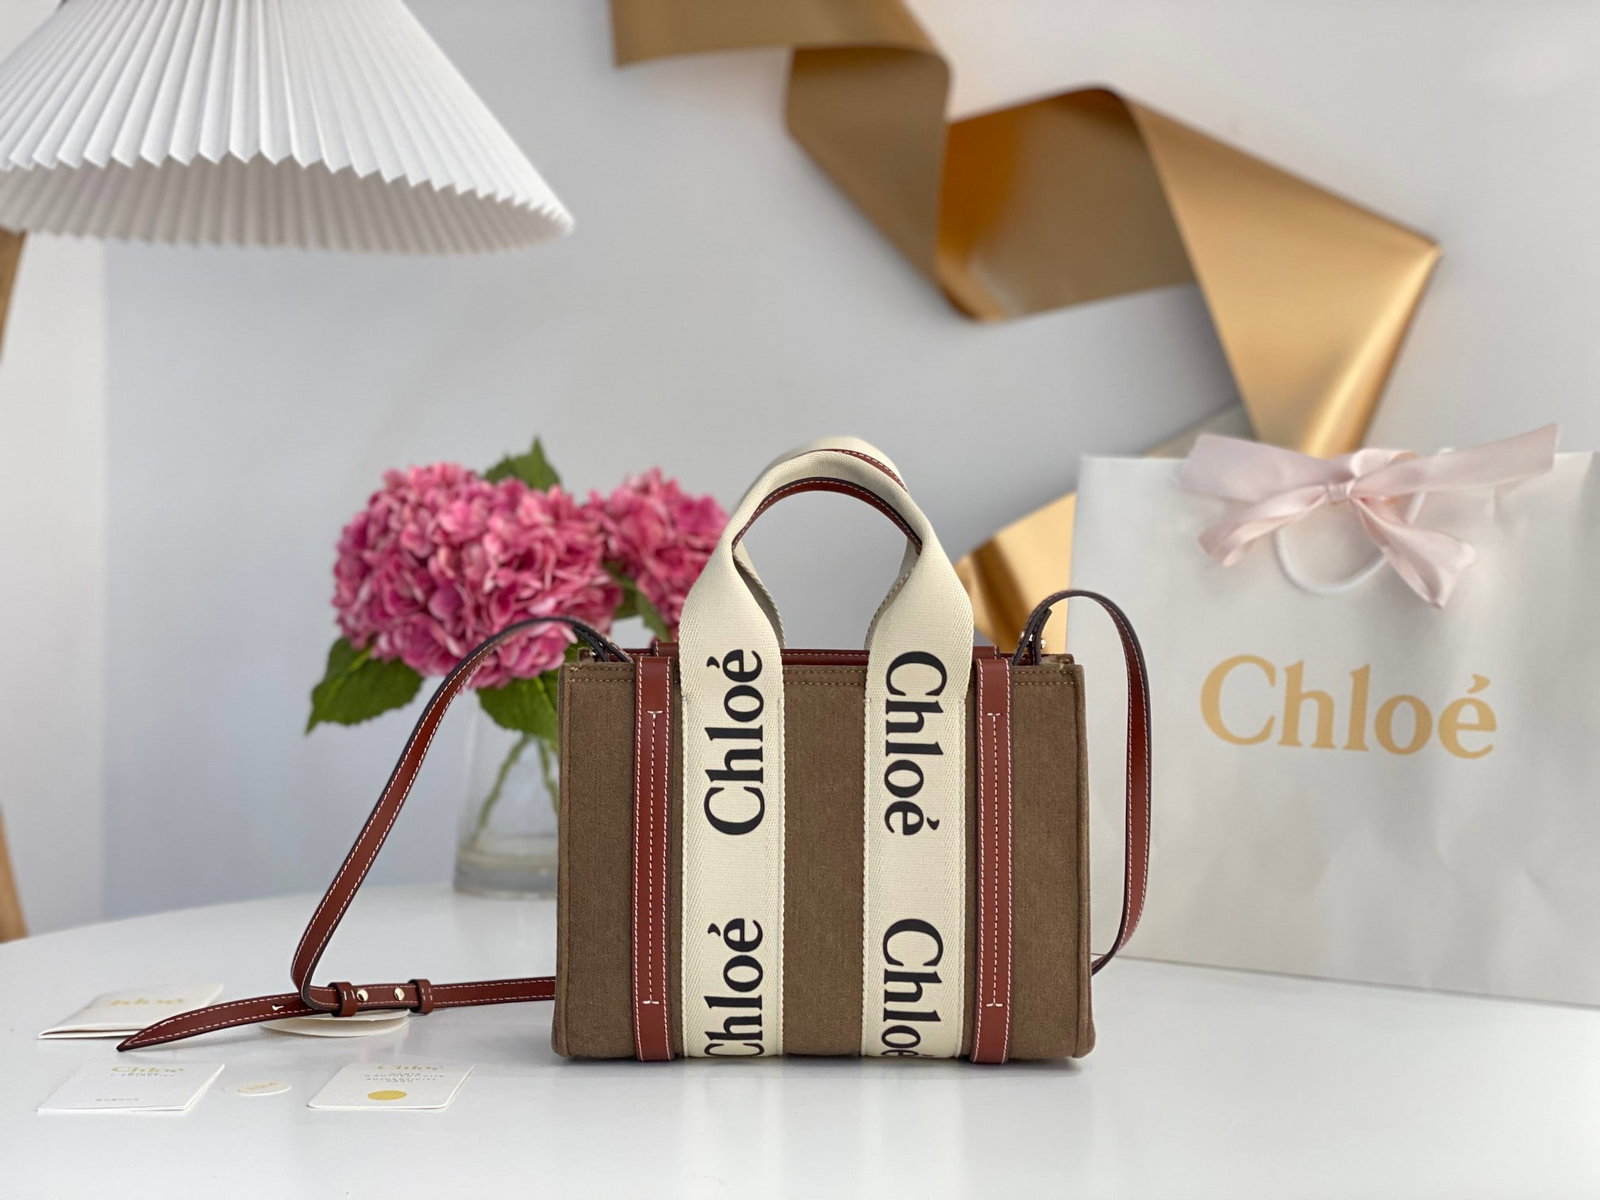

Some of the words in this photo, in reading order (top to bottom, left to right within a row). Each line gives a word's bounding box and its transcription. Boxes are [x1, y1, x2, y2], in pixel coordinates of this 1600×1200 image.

[704, 649, 764, 835] Chloé
[884, 651, 947, 835] Chloé
[1201, 654, 1497, 759] Chloé
